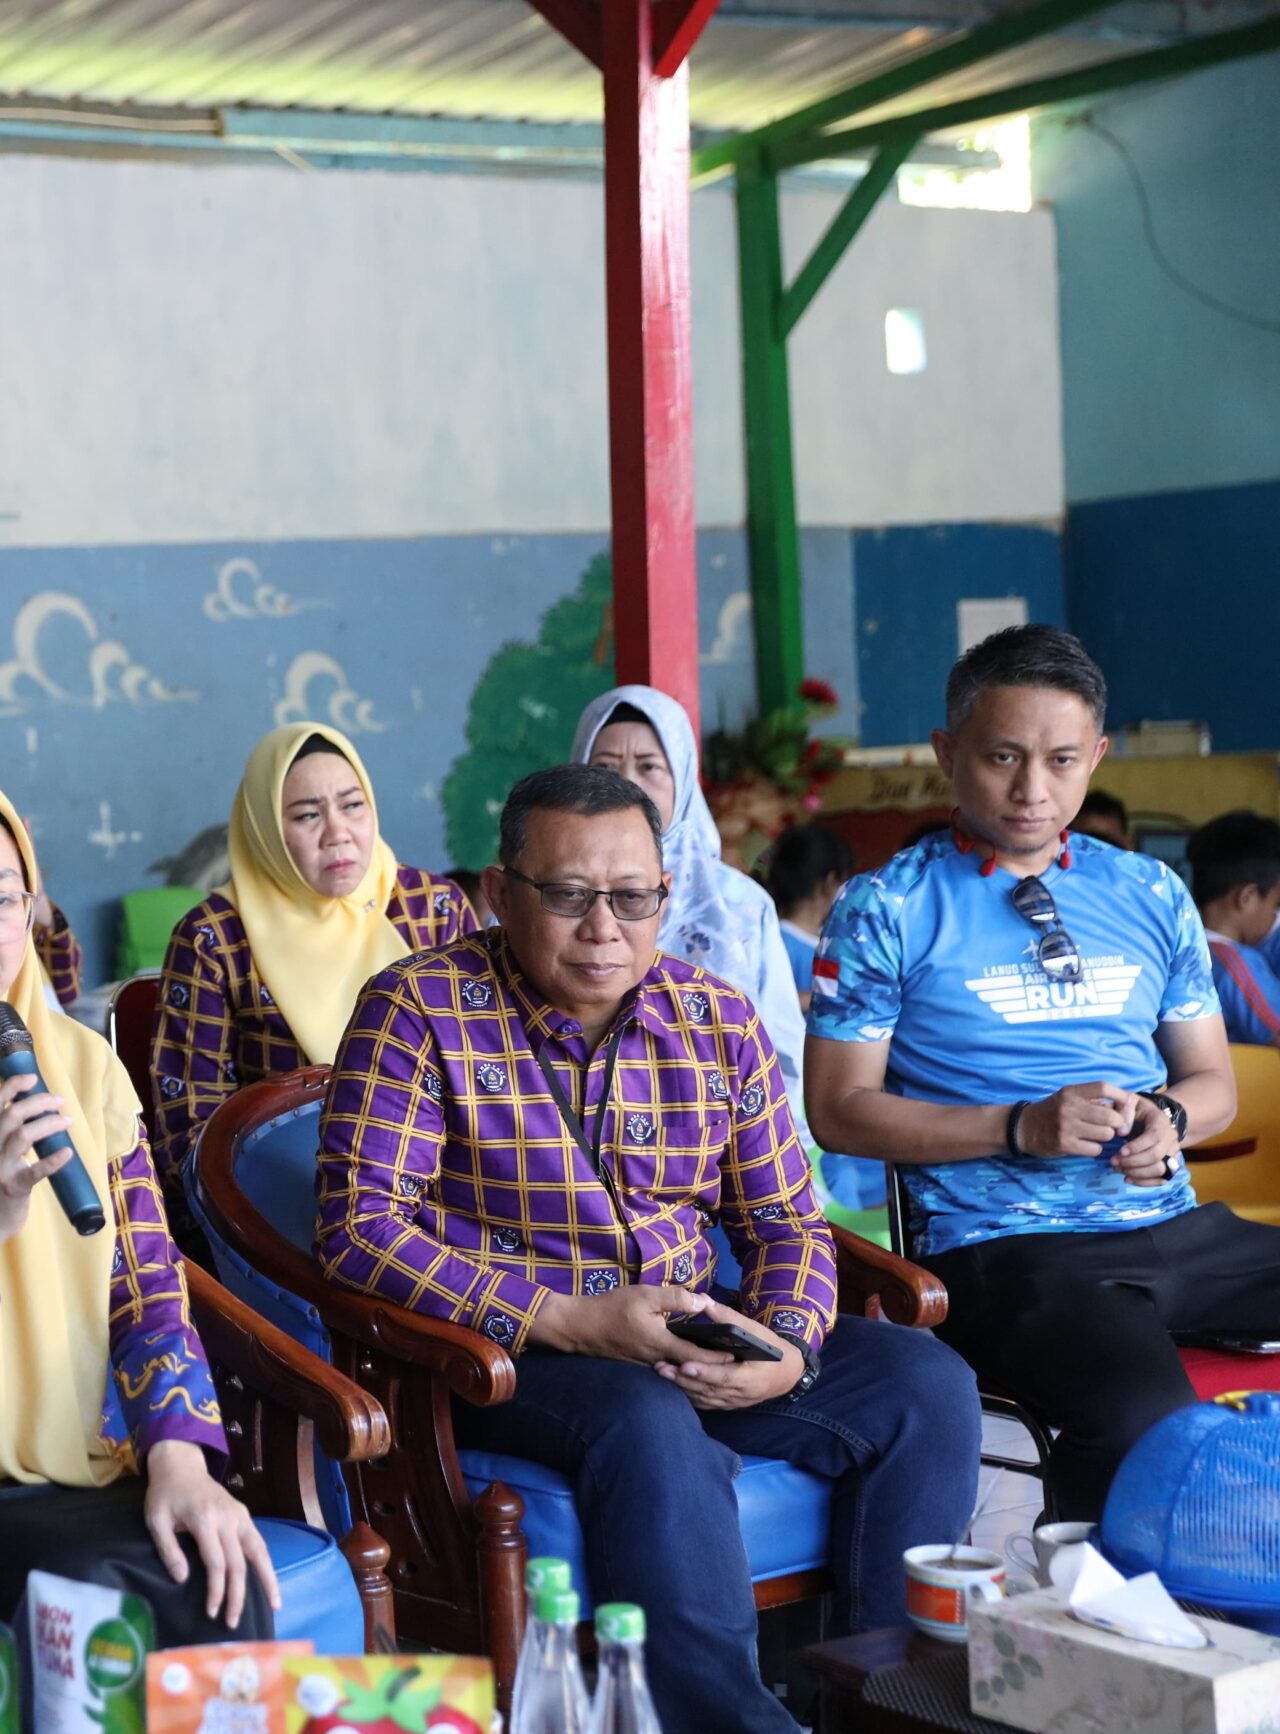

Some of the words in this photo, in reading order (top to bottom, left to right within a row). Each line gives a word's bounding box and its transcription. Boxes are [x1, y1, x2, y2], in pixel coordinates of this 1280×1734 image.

[983, 963, 1019, 978] LANUD
[1021, 962, 1042, 974] SUL
[1025, 973, 1049, 985] AIR
[1025, 980, 1100, 1010] RUN
